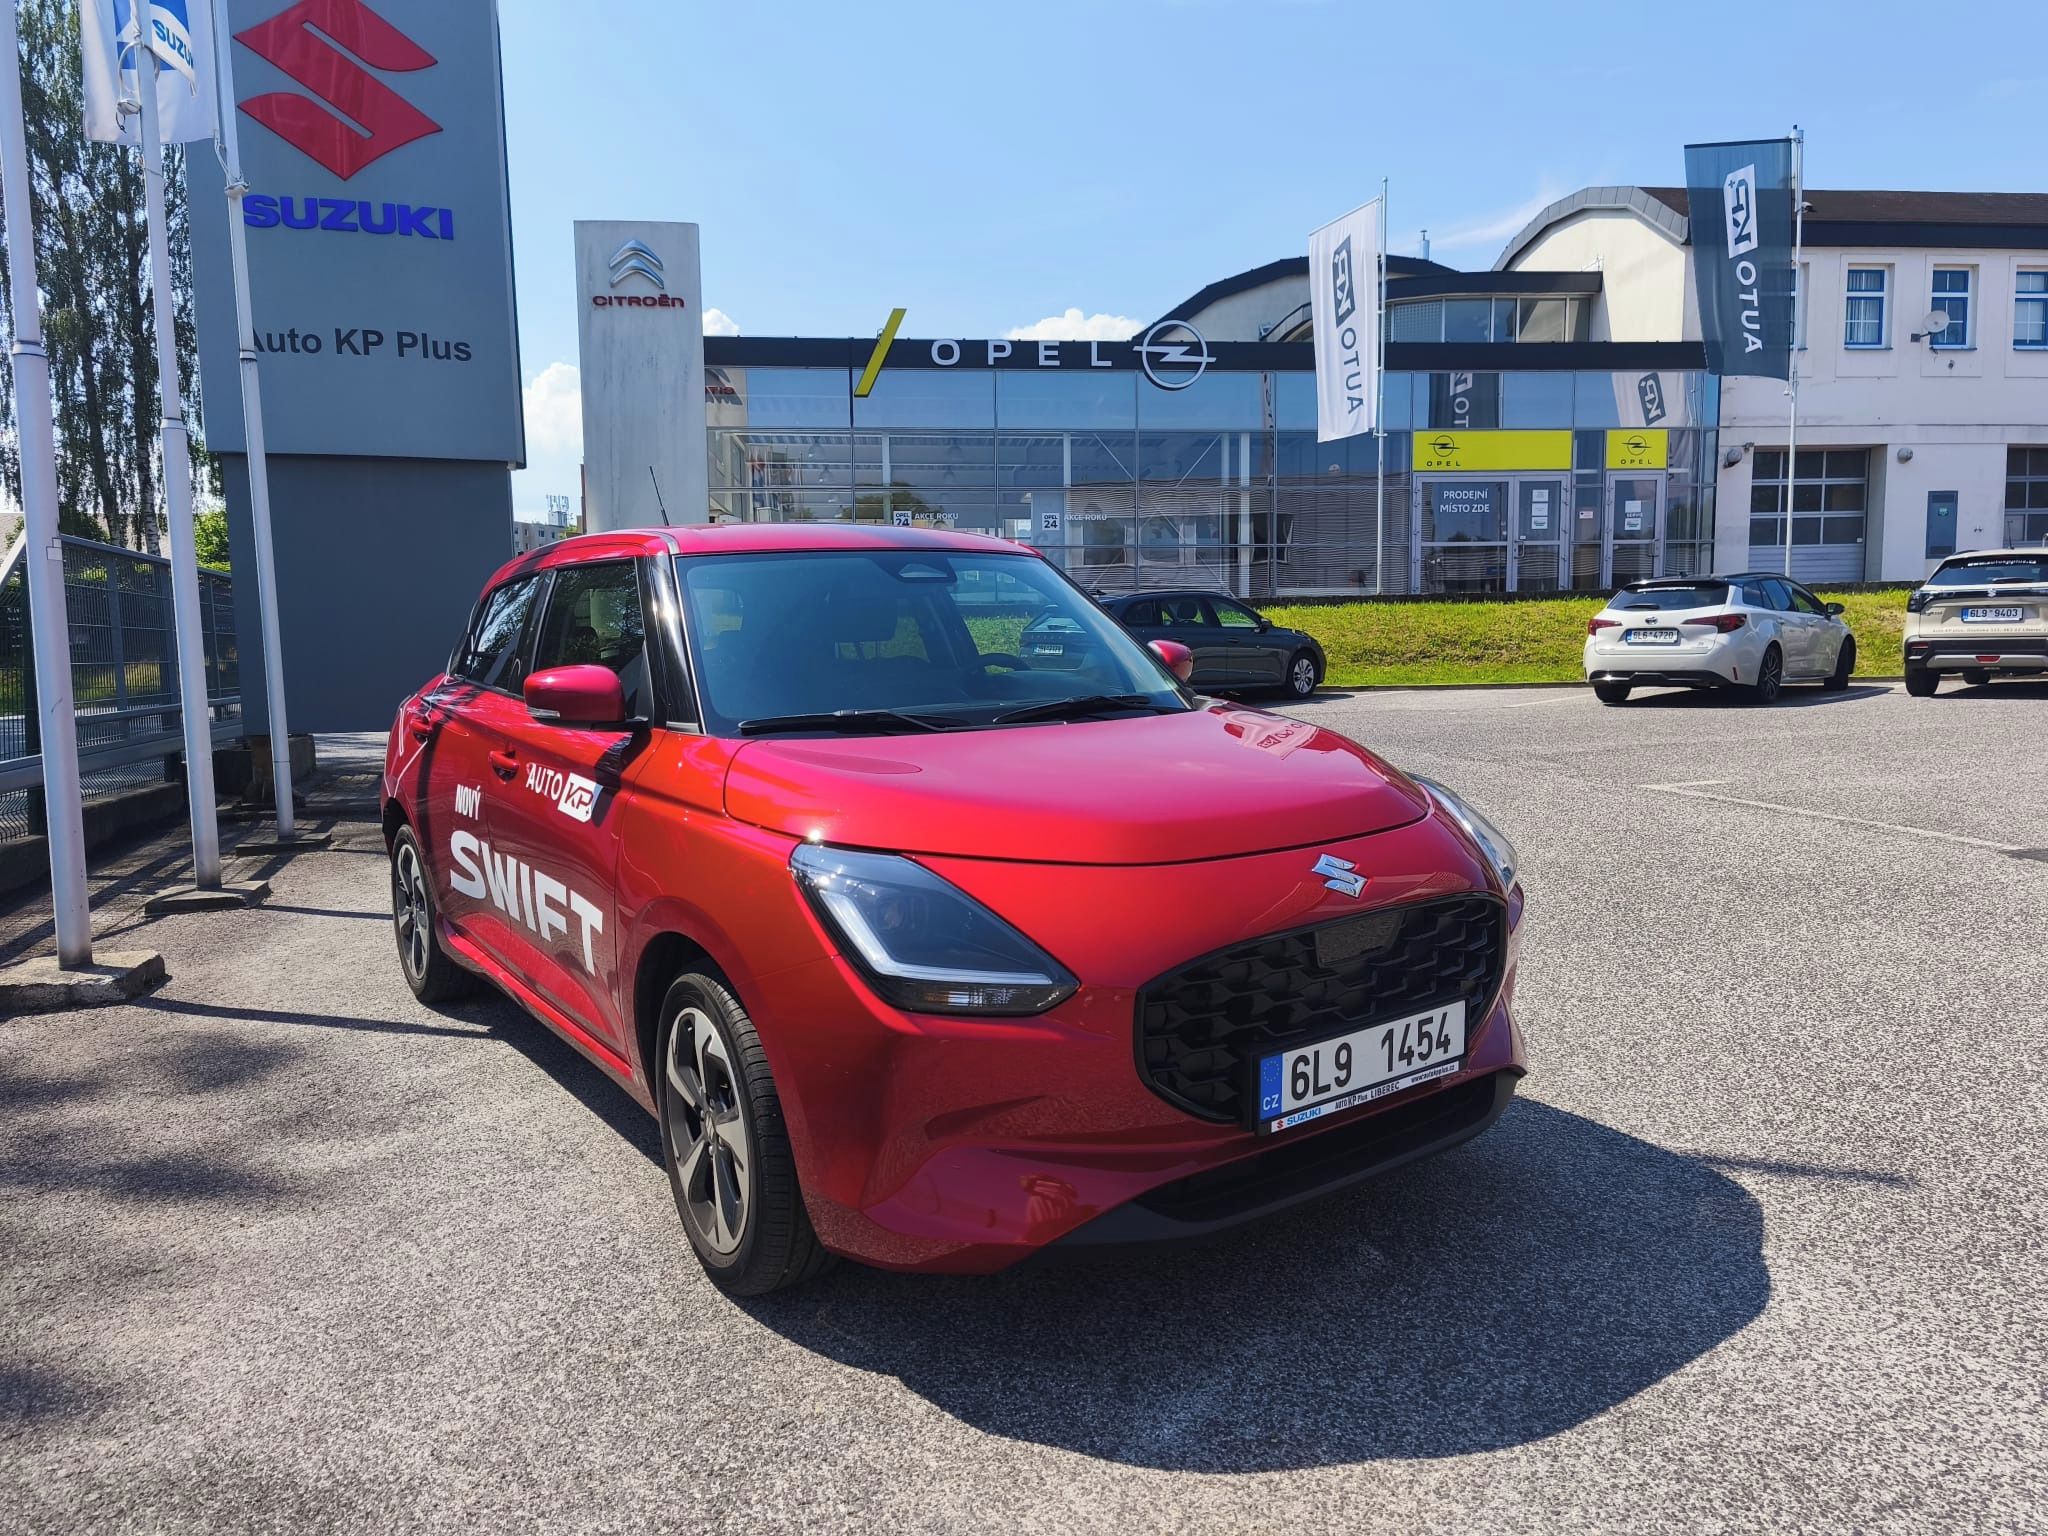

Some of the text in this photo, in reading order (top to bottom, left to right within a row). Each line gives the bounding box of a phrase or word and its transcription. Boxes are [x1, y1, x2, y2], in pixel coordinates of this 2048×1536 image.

[242, 194, 454, 241] SUZUKI
[334, 327, 385, 356] KP
[396, 330, 473, 362] Plus
[930, 339, 1113, 367] OPEL
[1439, 502, 1490, 513] MÍSTO ZDE
[1443, 488, 1489, 501] PRODEJNÍ
[914, 512, 959, 520] AKCE ROKU
[1043, 520, 1058, 529] 24
[1970, 608, 2018, 618] 6L9 9403
[1653, 631, 1674, 640] 4720
[526, 763, 563, 801] AUTO
[454, 783, 482, 821] NOVÝ
[450, 830, 603, 977] SWIFT
[1291, 1012, 1451, 1101] 6L9 1454
[1263, 1093, 1279, 1111] CZ
[1286, 1107, 1322, 1126] SUZUKI
[1335, 1099, 1348, 1111] AUTO
[1347, 1094, 1357, 1106] KP
[1370, 1081, 1400, 1099] LIBEREC
